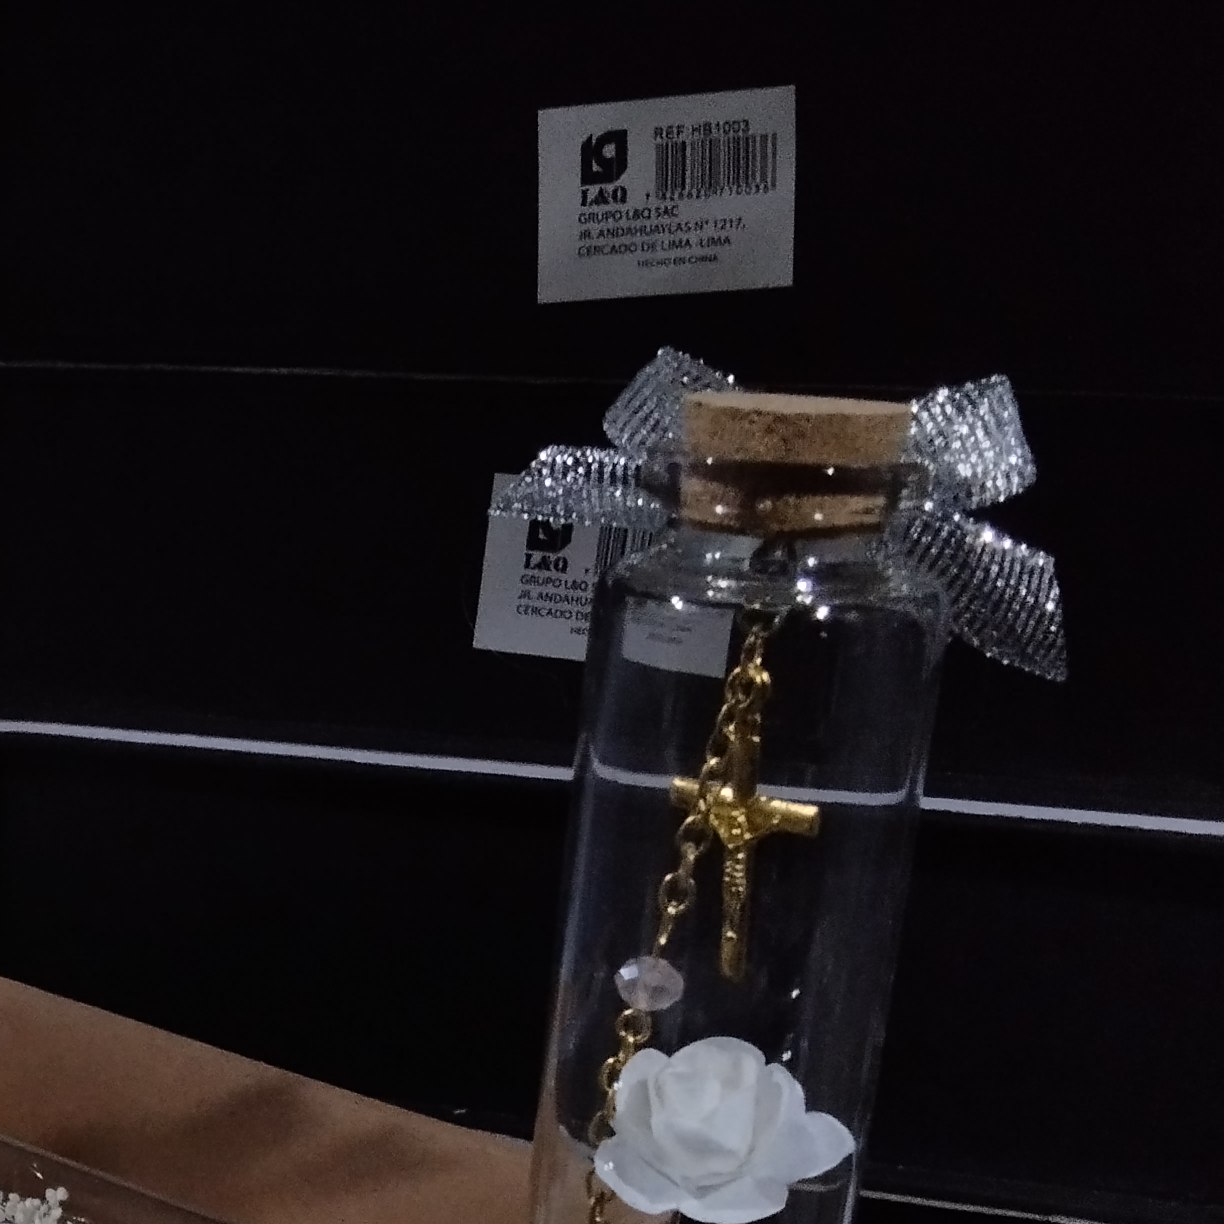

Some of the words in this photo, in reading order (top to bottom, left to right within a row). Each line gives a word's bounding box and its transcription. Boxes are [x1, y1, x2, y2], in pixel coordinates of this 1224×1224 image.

[578, 209, 623, 225] GRUPO
[625, 207, 652, 221] L&Q
[654, 205, 680, 218] SAC
[596, 220, 693, 240] ANDAHUAYLAS
[577, 241, 638, 258] CERCADO
[641, 241, 658, 253] DE
[661, 238, 693, 250] LIMA
[637, 257, 672, 268] HECHO
[672, 257, 686, 266] EN
[687, 254, 719, 264] CHINA
[520, 573, 562, 589] GRUPO
[564, 579, 589, 592] L&Q
[516, 604, 573, 620] CERCADO
